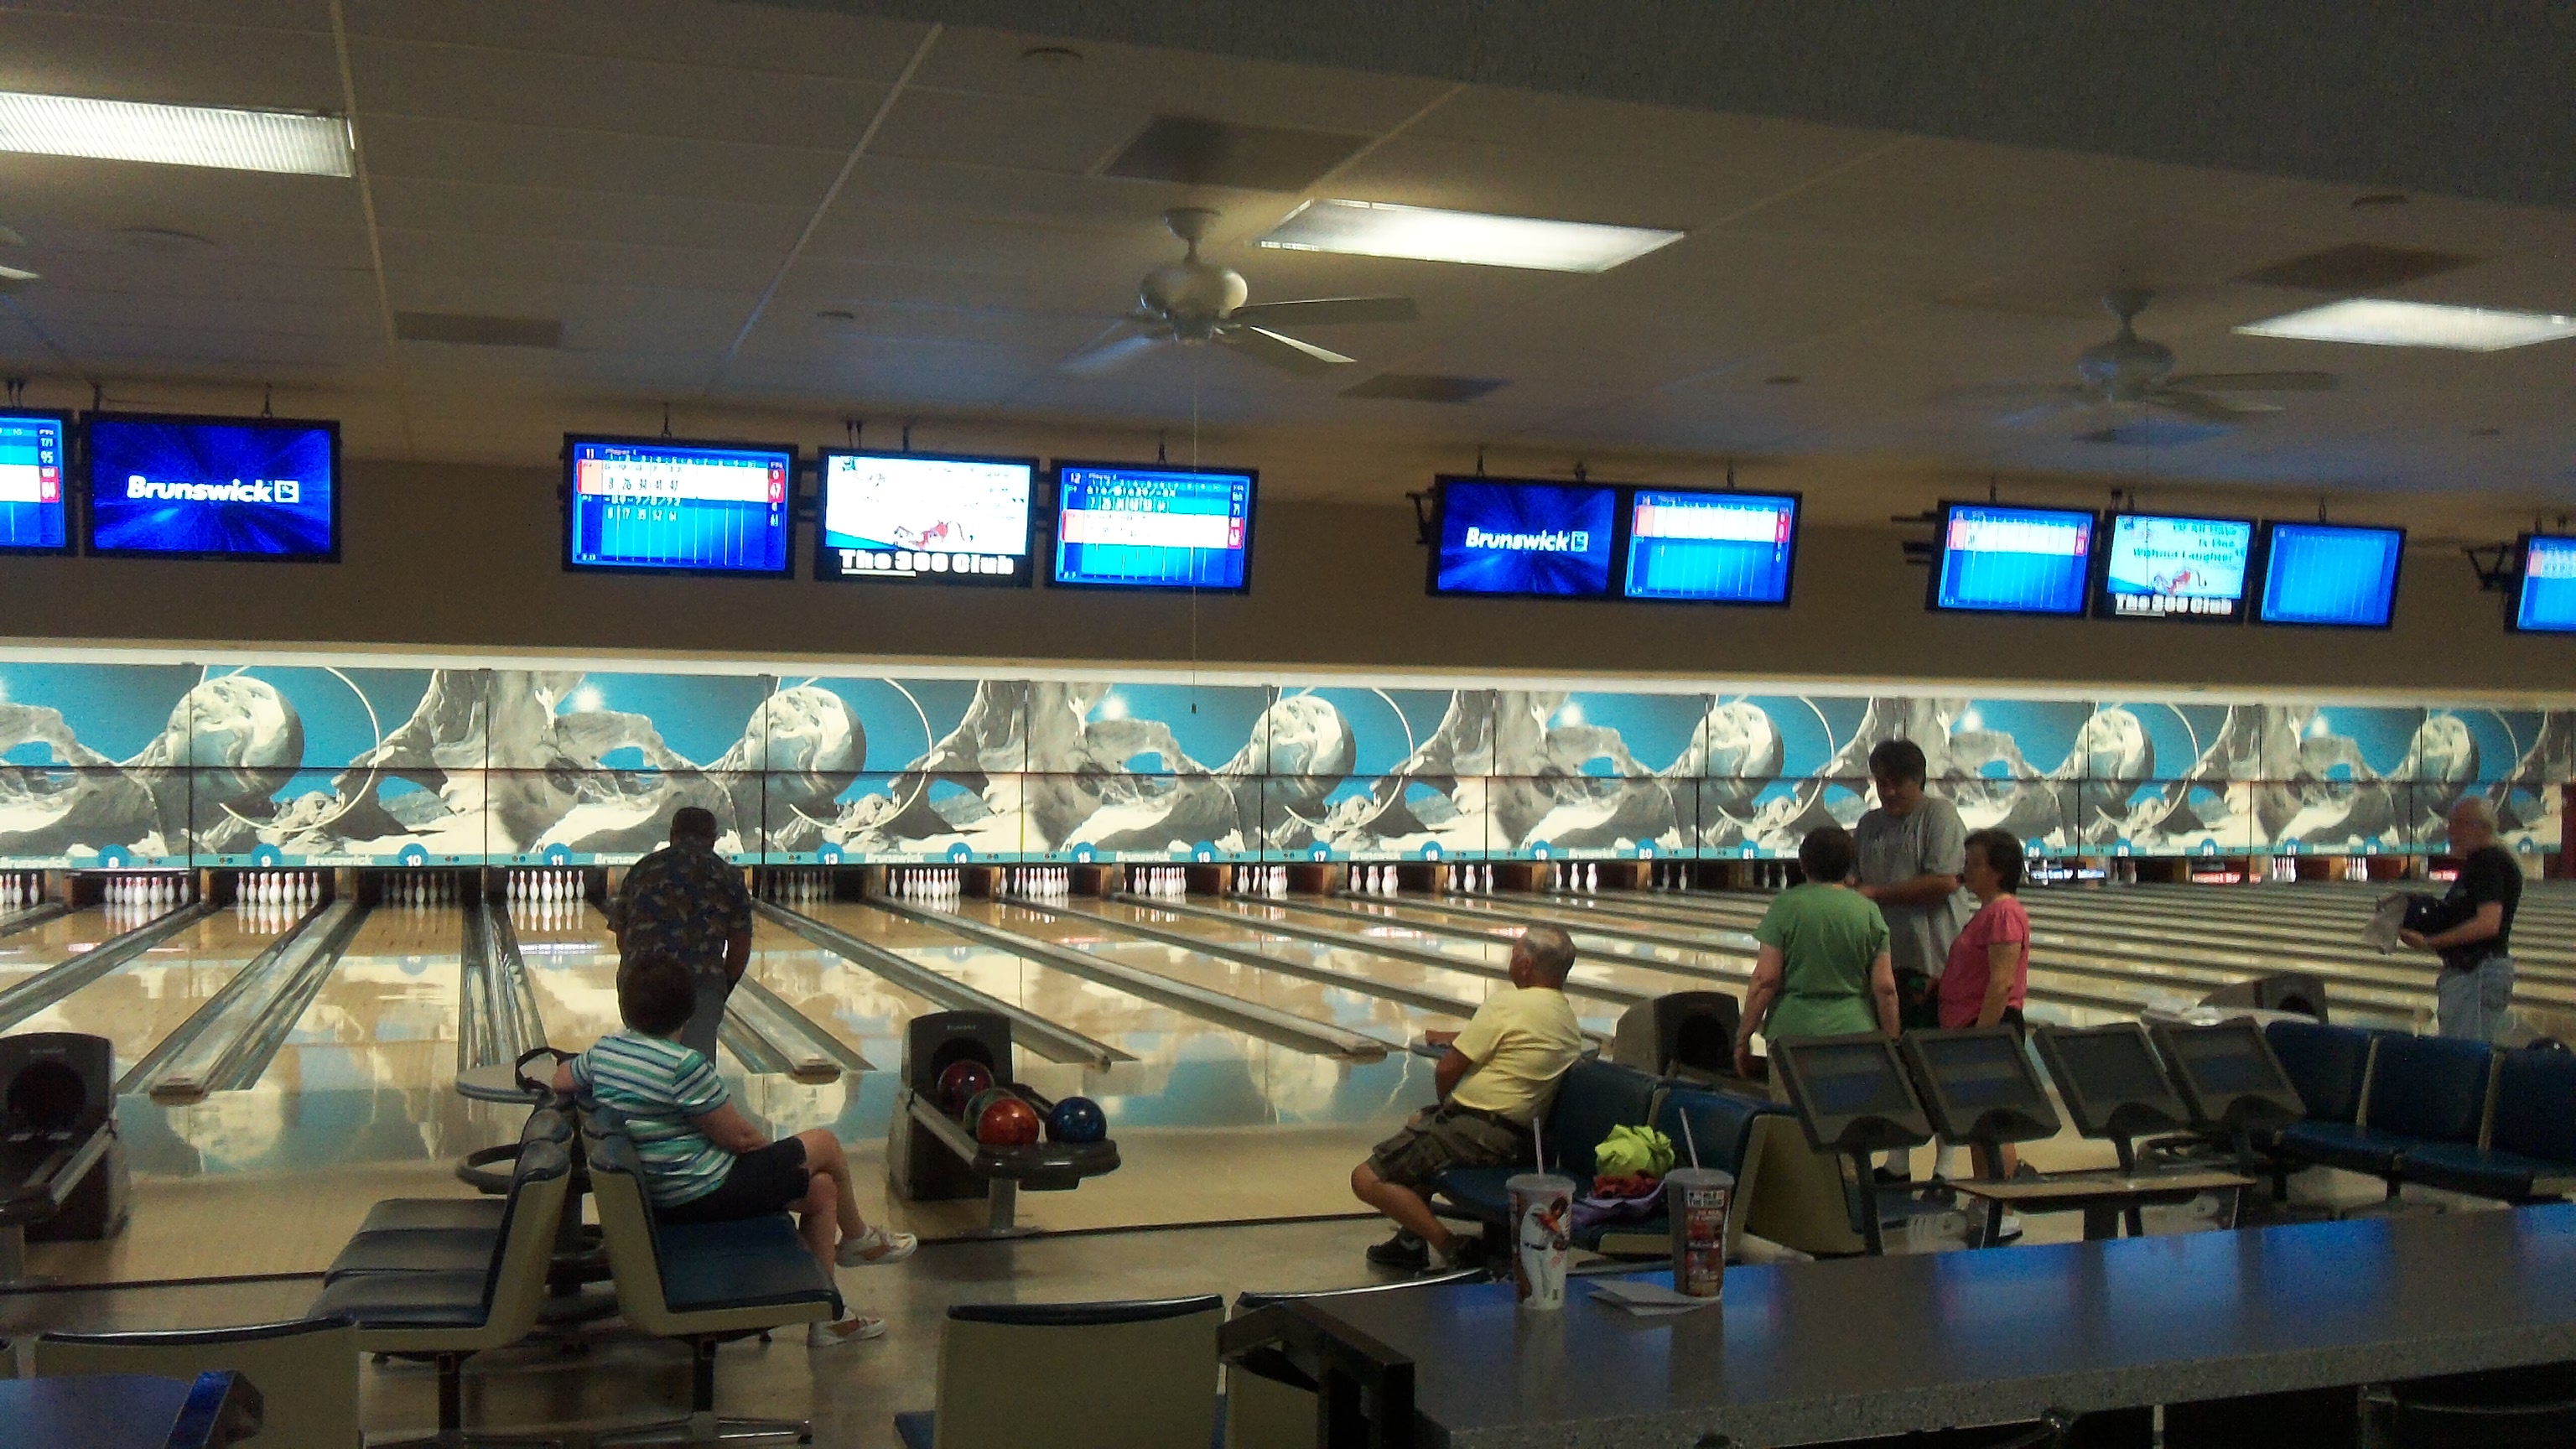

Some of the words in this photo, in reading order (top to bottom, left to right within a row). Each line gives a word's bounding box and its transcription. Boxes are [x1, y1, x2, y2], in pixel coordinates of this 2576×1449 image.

[40, 450, 54, 464] 95
[585, 448, 595, 459] 11
[127, 475, 273, 504] Brunswick
[1466, 527, 1570, 552] Brunswick
[839, 549, 891, 570] The
[895, 551, 948, 573] 300
[952, 553, 1014, 574] Club
[261, 855, 272, 866] 9
[305, 854, 375, 866] Brunswick
[406, 854, 422, 867] 10
[550, 854, 564, 866] 11
[823, 852, 839, 865] 13
[865, 852, 925, 865] Brunswick
[952, 852, 968, 865] 14
[1077, 851, 1091, 864] 15
[1115, 850, 1171, 863] Brunswick
[1312, 849, 1327, 862] 17
